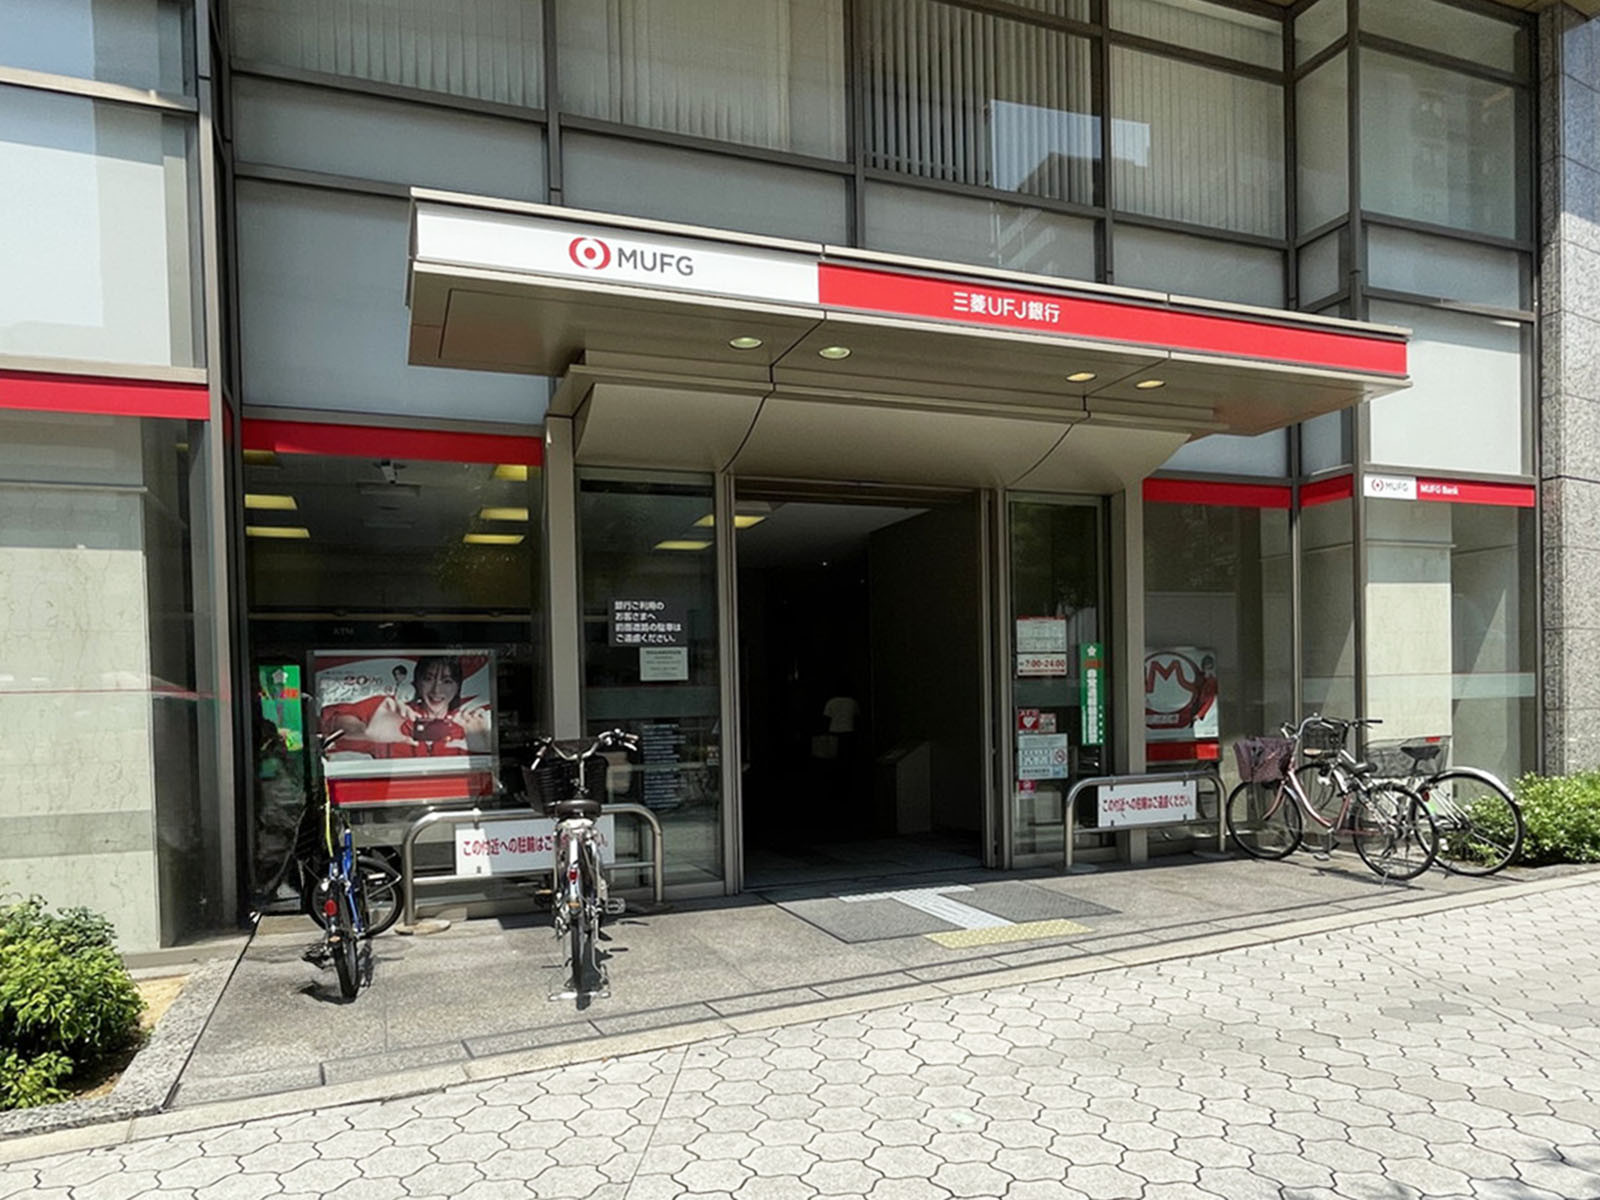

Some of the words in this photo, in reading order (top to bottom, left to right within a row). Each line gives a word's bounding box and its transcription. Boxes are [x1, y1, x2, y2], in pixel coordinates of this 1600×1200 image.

[617, 247, 694, 276] MUFG
[953, 291, 1061, 323] 三菱UFJ銀行
